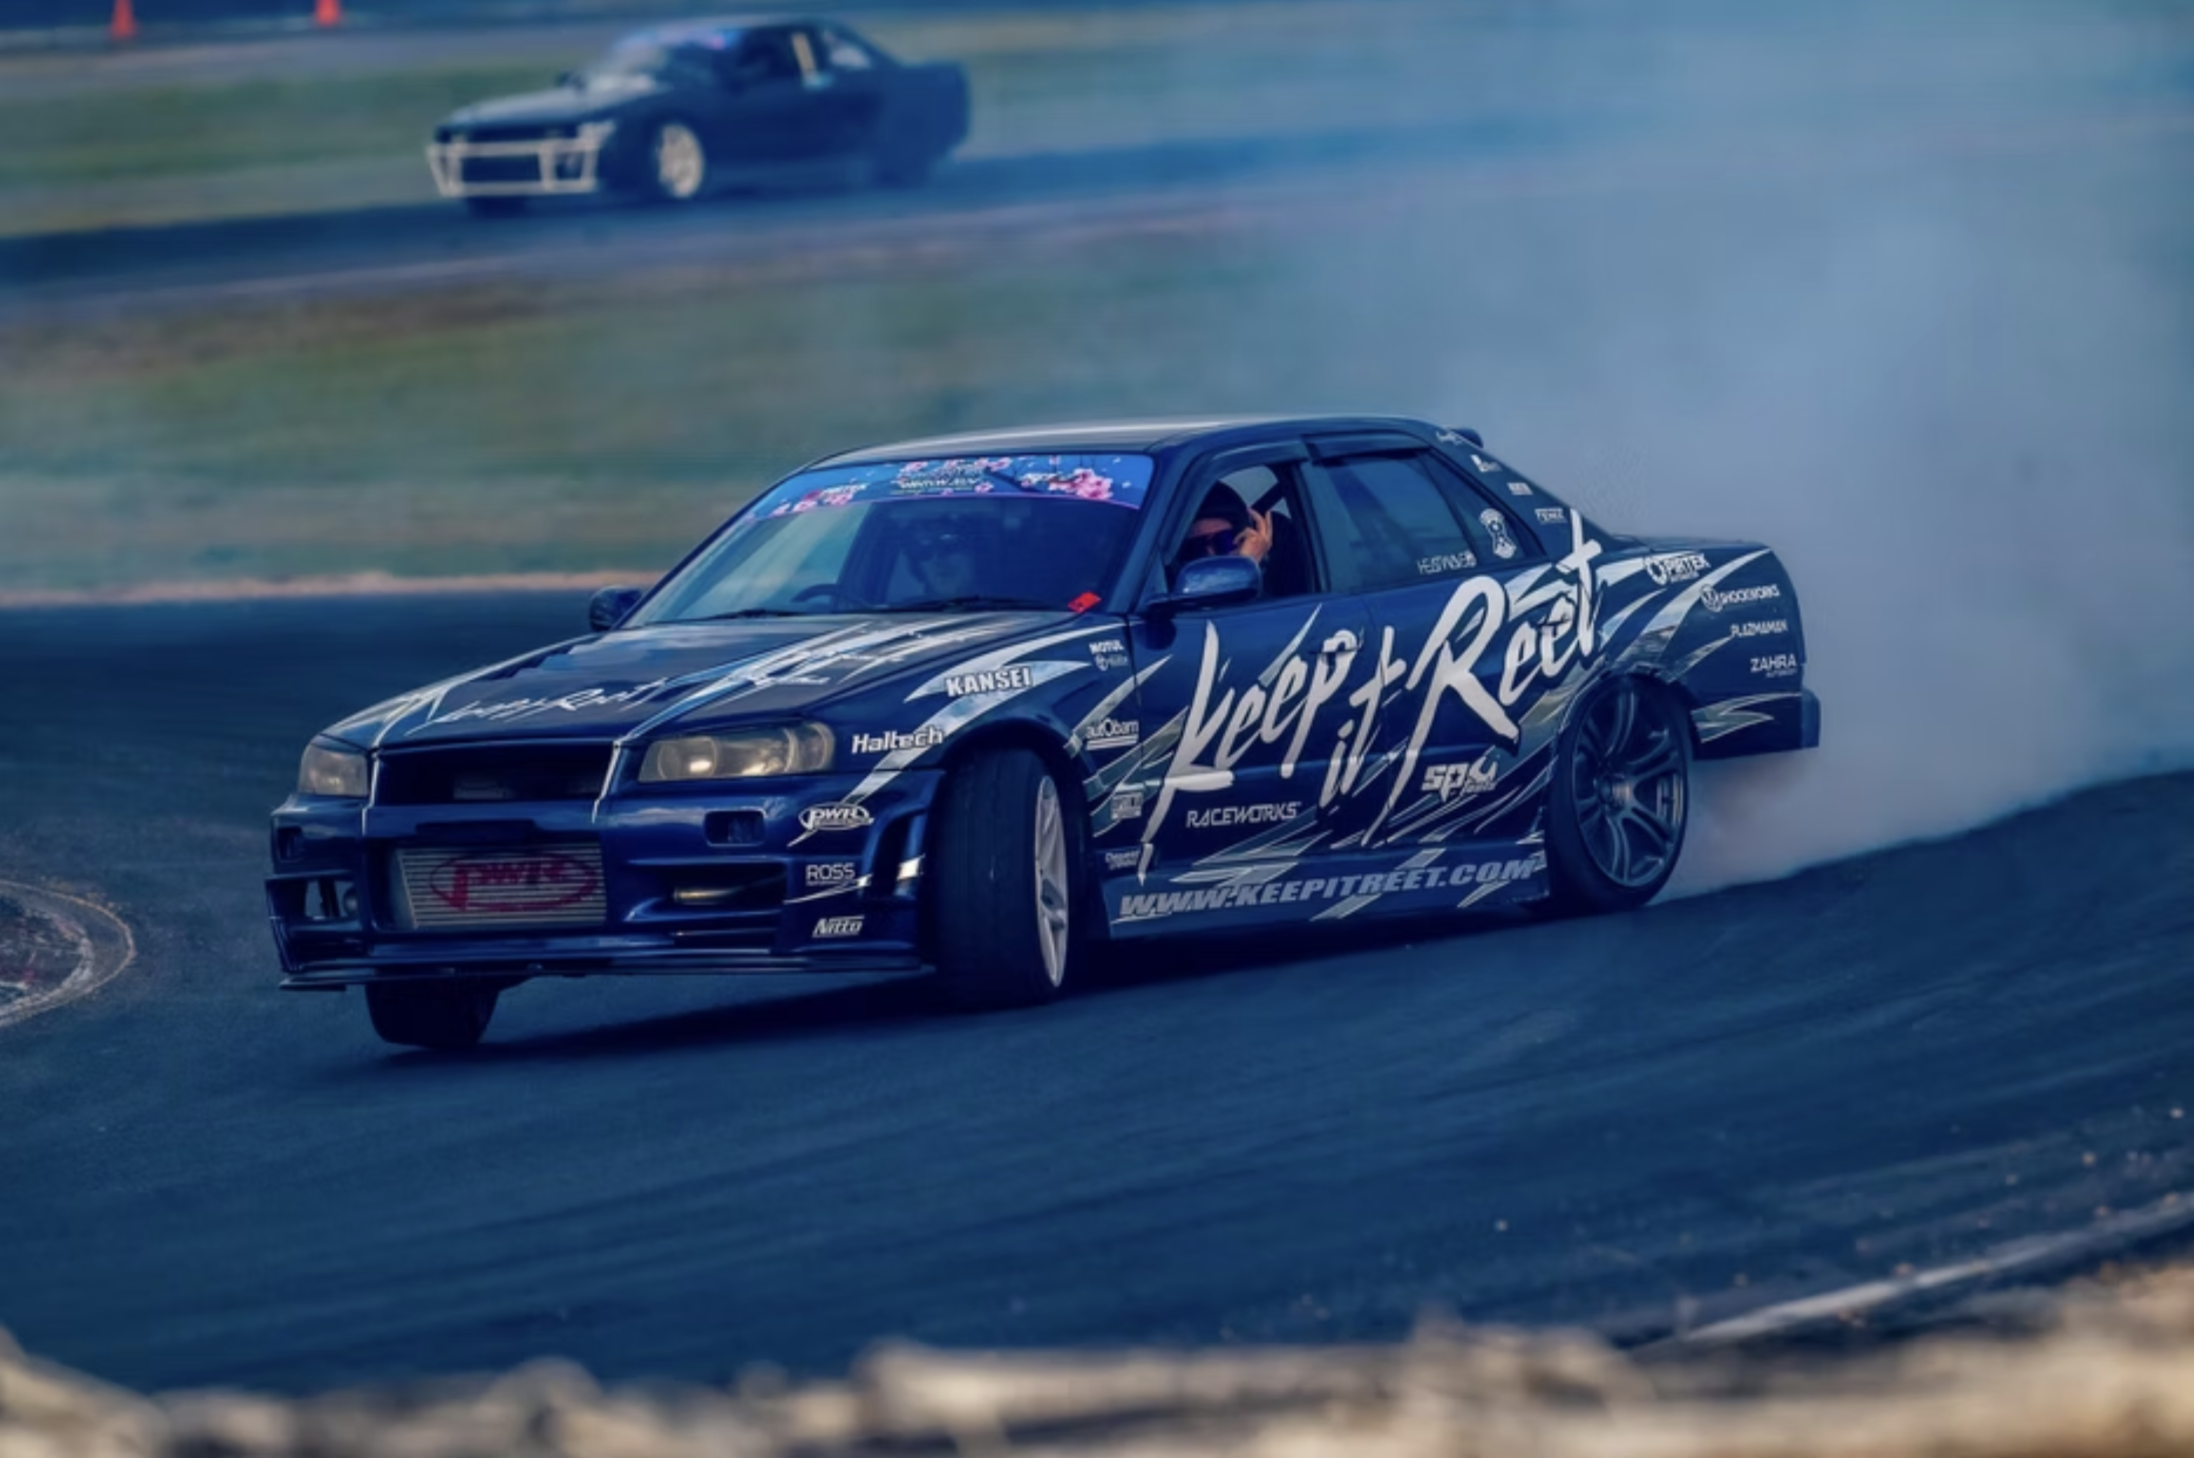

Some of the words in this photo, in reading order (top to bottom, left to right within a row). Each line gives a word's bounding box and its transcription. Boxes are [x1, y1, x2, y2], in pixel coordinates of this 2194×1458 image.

[1750, 654, 1796, 672] ZAHRA
[945, 665, 1032, 697] KANSEI
[1361, 509, 1602, 847] Reet
[851, 724, 943, 754] Haltech
[1186, 804, 1298, 828] RACEWORKS
[805, 863, 855, 881] ROSS
[811, 914, 865, 939] Nitto
